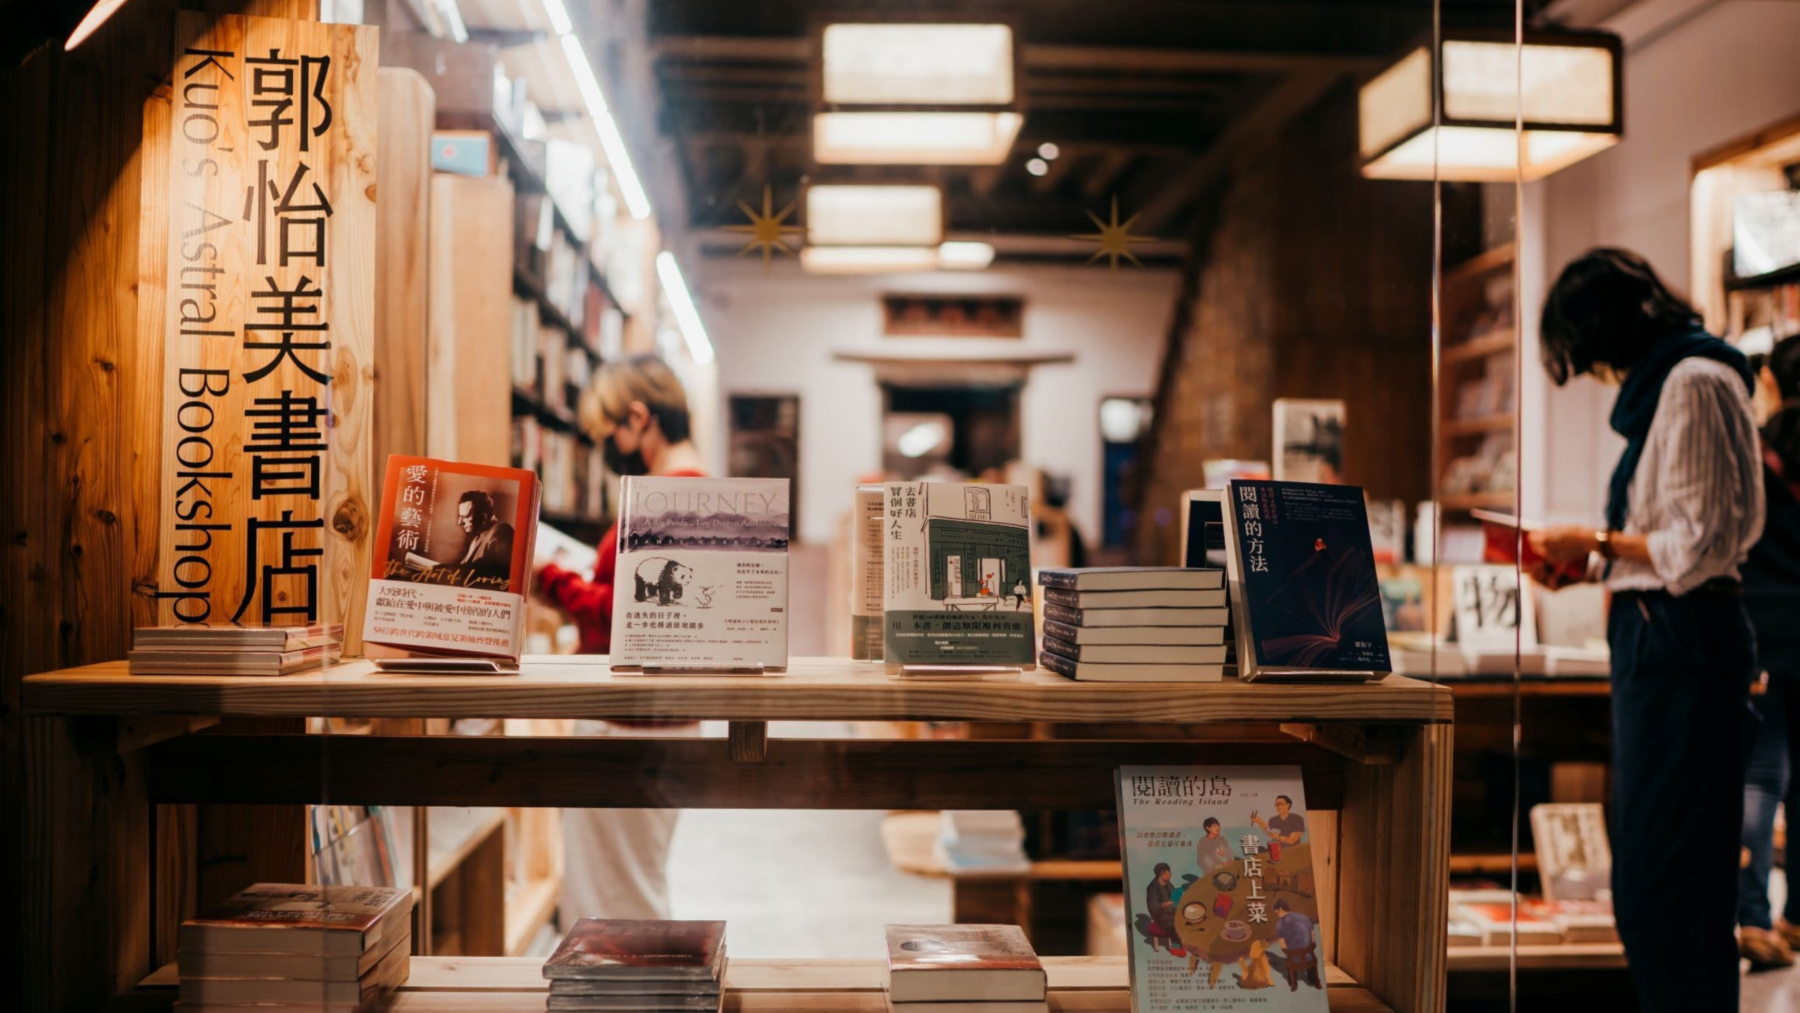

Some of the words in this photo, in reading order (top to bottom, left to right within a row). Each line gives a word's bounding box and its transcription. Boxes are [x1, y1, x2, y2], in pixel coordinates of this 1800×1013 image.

[181, 48, 235, 177] Kuo's
[180, 200, 235, 337] Astral
[231, 48, 334, 623] 郭怡美書店
[154, 367, 233, 623] Bookshop
[397, 465, 428, 551] 愛的藝術
[635, 491, 777, 515] JOURNEY
[653, 519, 664, 528] Big
[712, 519, 739, 528] Dragon
[890, 486, 902, 540] 買個好人生
[905, 486, 917, 518] 去書店
[1239, 486, 1269, 573] 閱讀的方法
[1131, 775, 1232, 797] 閱讀的島
[1154, 798, 1194, 807] Reading
[1240, 834, 1268, 924] 書店上菜
